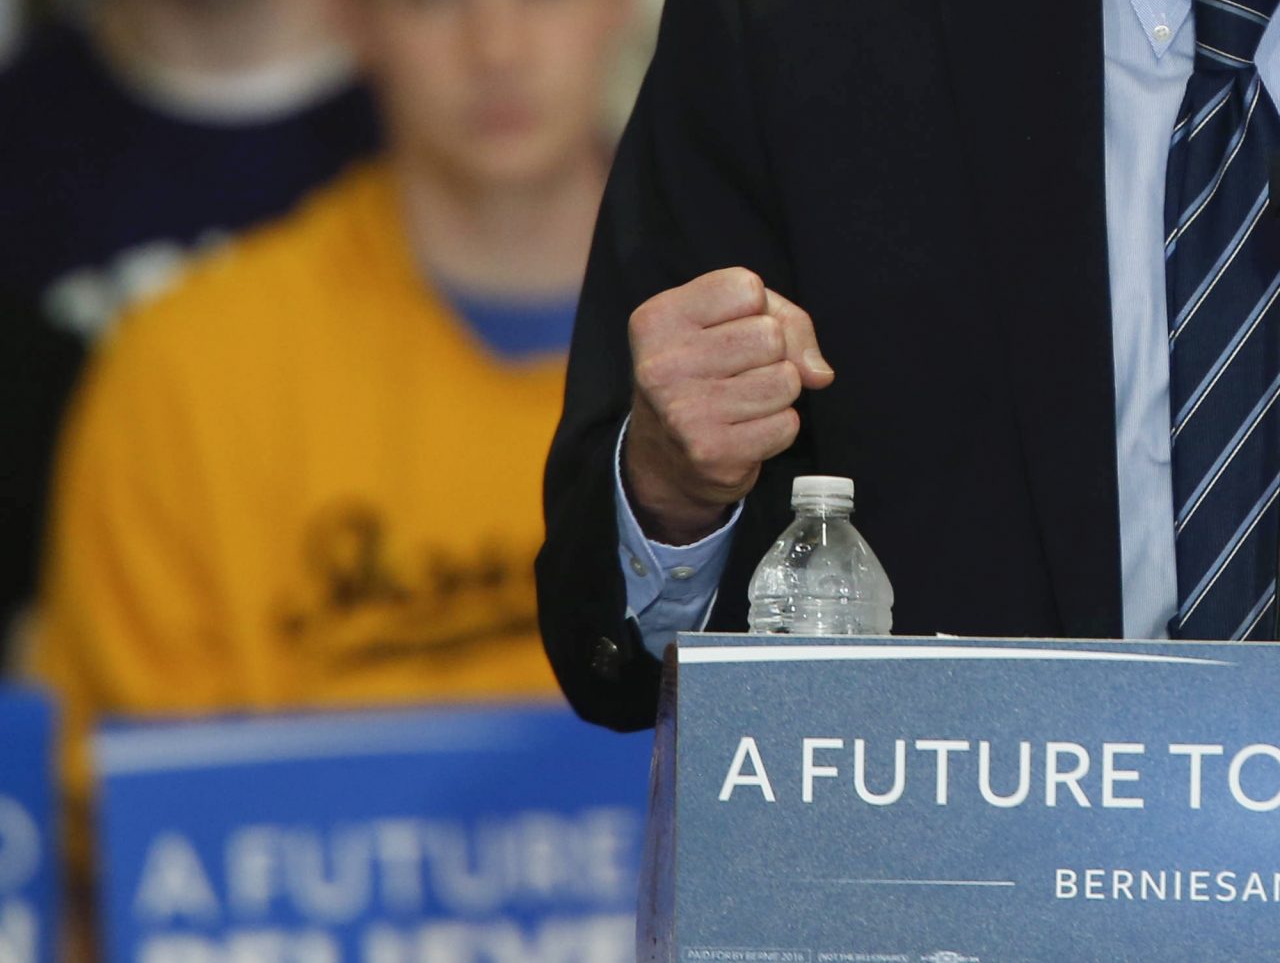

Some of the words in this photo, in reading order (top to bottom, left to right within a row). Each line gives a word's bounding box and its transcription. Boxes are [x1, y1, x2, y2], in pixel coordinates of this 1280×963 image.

[719, 736, 776, 802] A
[802, 738, 1145, 809] FUTURE
[133, 830, 221, 925] A
[224, 806, 641, 924] FUTURE
